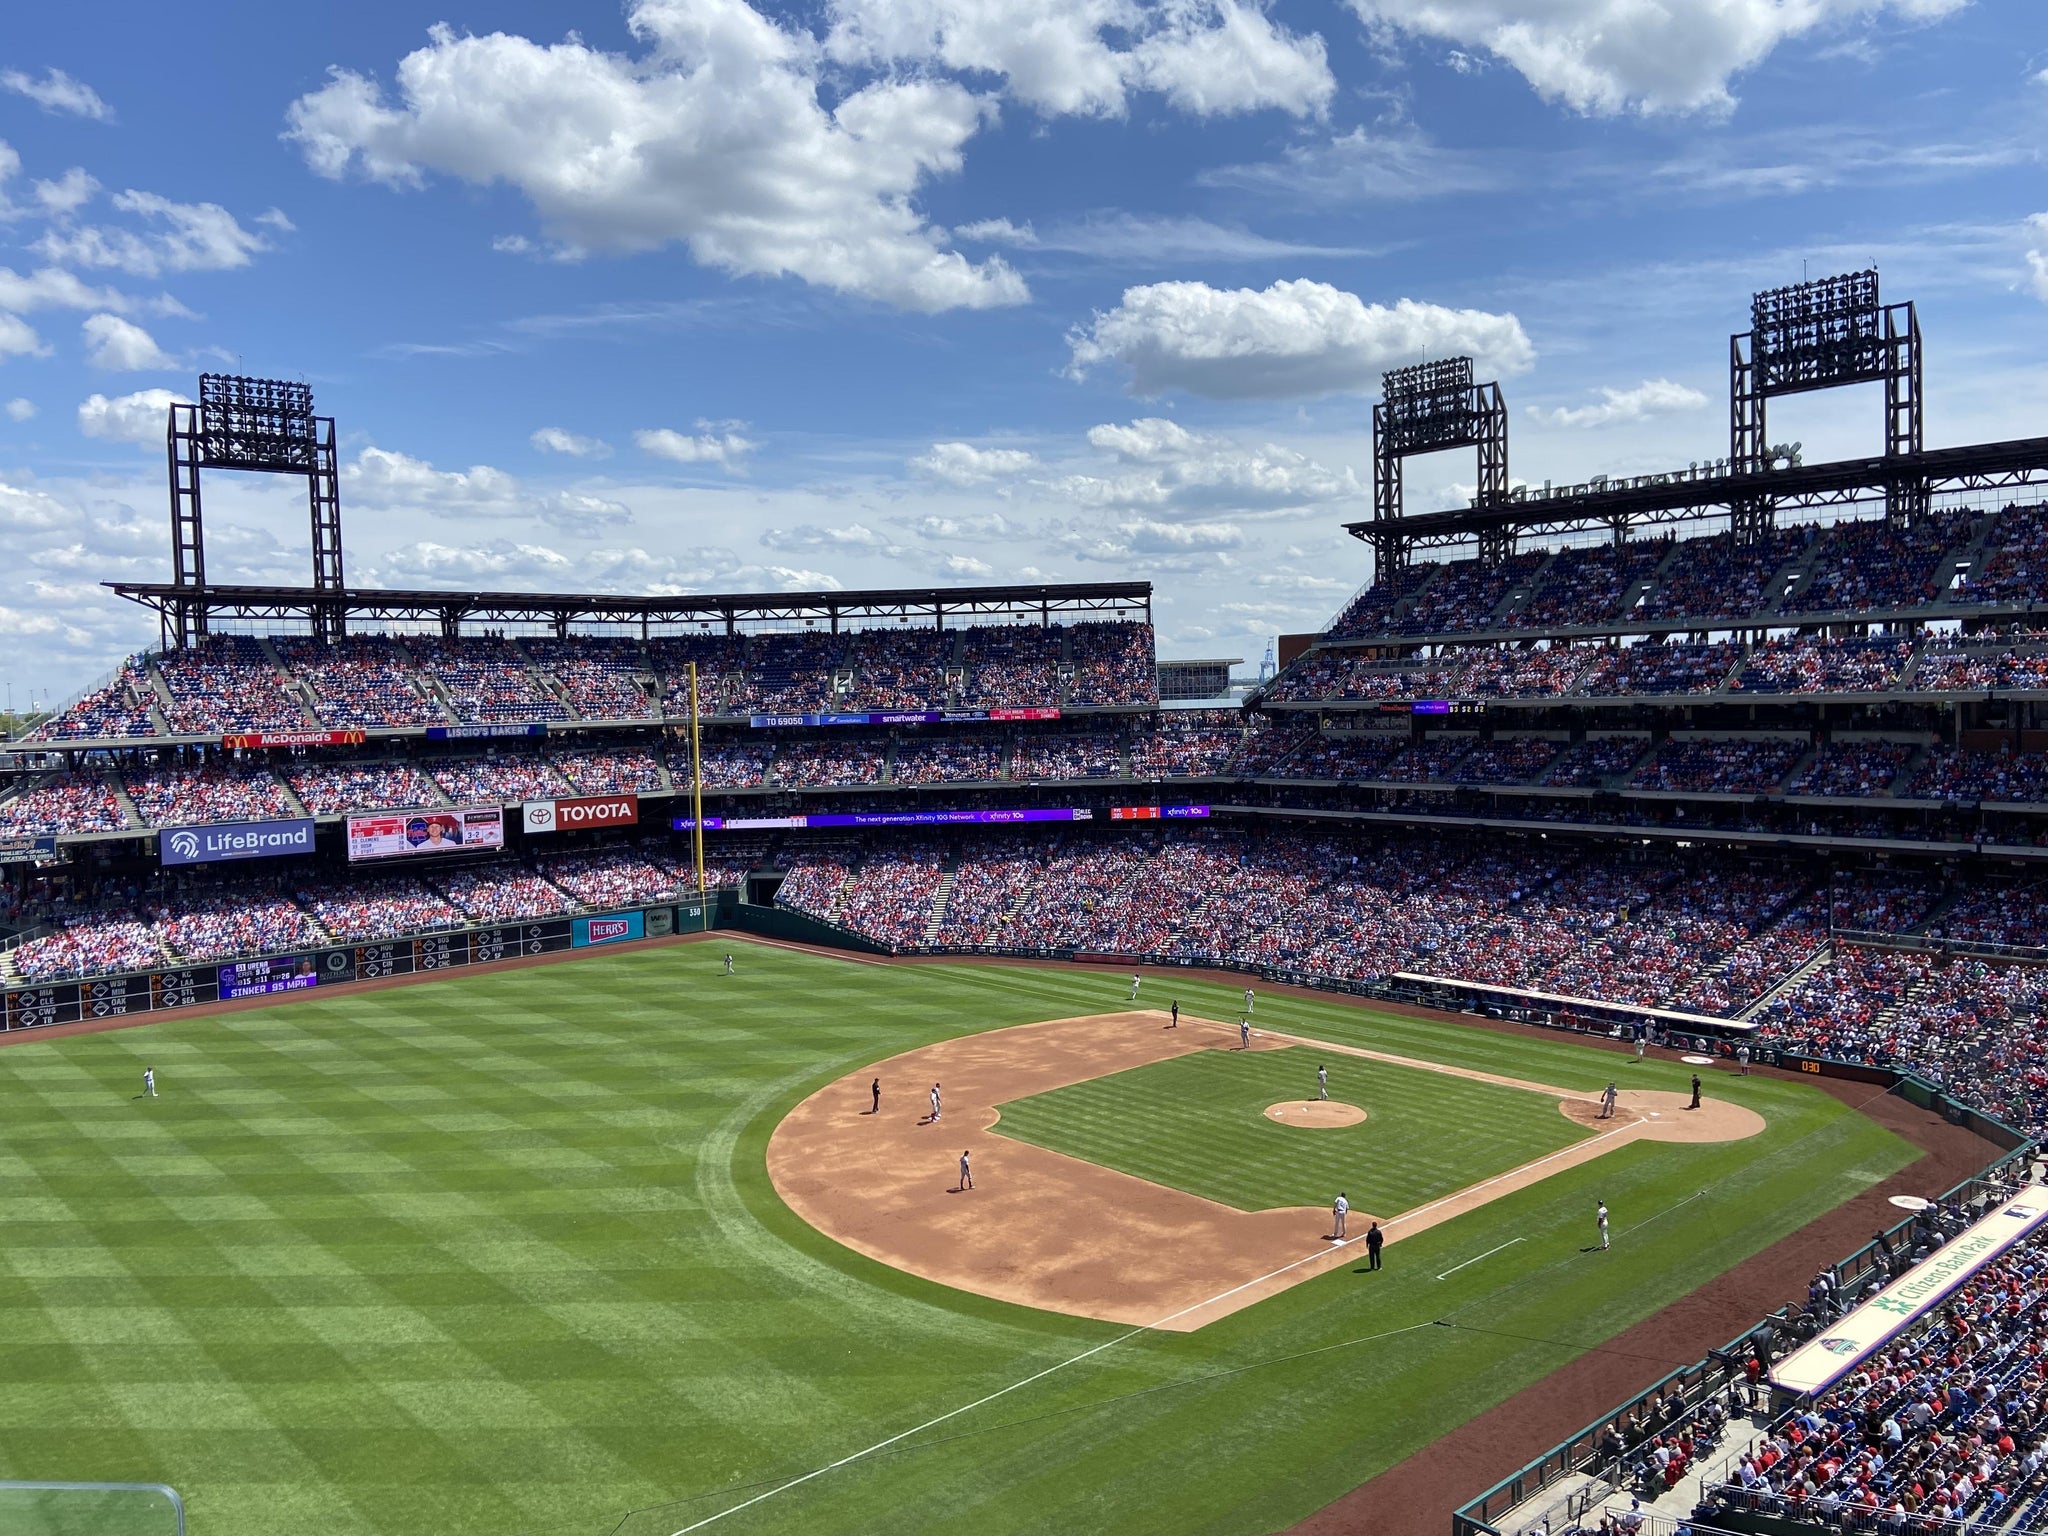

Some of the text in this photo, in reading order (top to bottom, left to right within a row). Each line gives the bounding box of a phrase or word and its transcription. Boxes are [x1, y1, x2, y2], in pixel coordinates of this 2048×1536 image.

[766, 717, 803, 726] TO 69050
[882, 713, 926, 723] smartwater
[446, 725, 530, 738] LISCIO'S BAKERY
[261, 732, 332, 744] McDonald's
[560, 802, 632, 822] TOYOTA
[1167, 808, 1188, 816] xfinity
[882, 815, 914, 823] generation
[915, 814, 935, 822] Xfinity
[989, 812, 1010, 822] xfinity
[207, 827, 307, 851] LifeBrand
[689, 908, 701, 917] 330
[593, 922, 624, 936] HERR'S
[438, 936, 450, 944] BOS
[438, 960, 450, 968] CHC
[181, 970, 191, 978] KC
[319, 968, 355, 978] ROTHMAN
[109, 979, 127, 988] WSH
[180, 979, 194, 987] LAA
[39, 988, 53, 997] MIA
[112, 988, 125, 996] MIN
[181, 988, 194, 996] STL
[231, 979, 307, 997] SINKER 95 MPH
[40, 997, 55, 1006] CLE
[111, 997, 126, 1006] OAK
[181, 996, 195, 1004] SEA
[38, 1007, 57, 1016] CWS
[112, 1006, 127, 1014] TEX
[43, 1016, 53, 1024] TB
[1896, 1235, 1997, 1300] Citizens Bank Park
